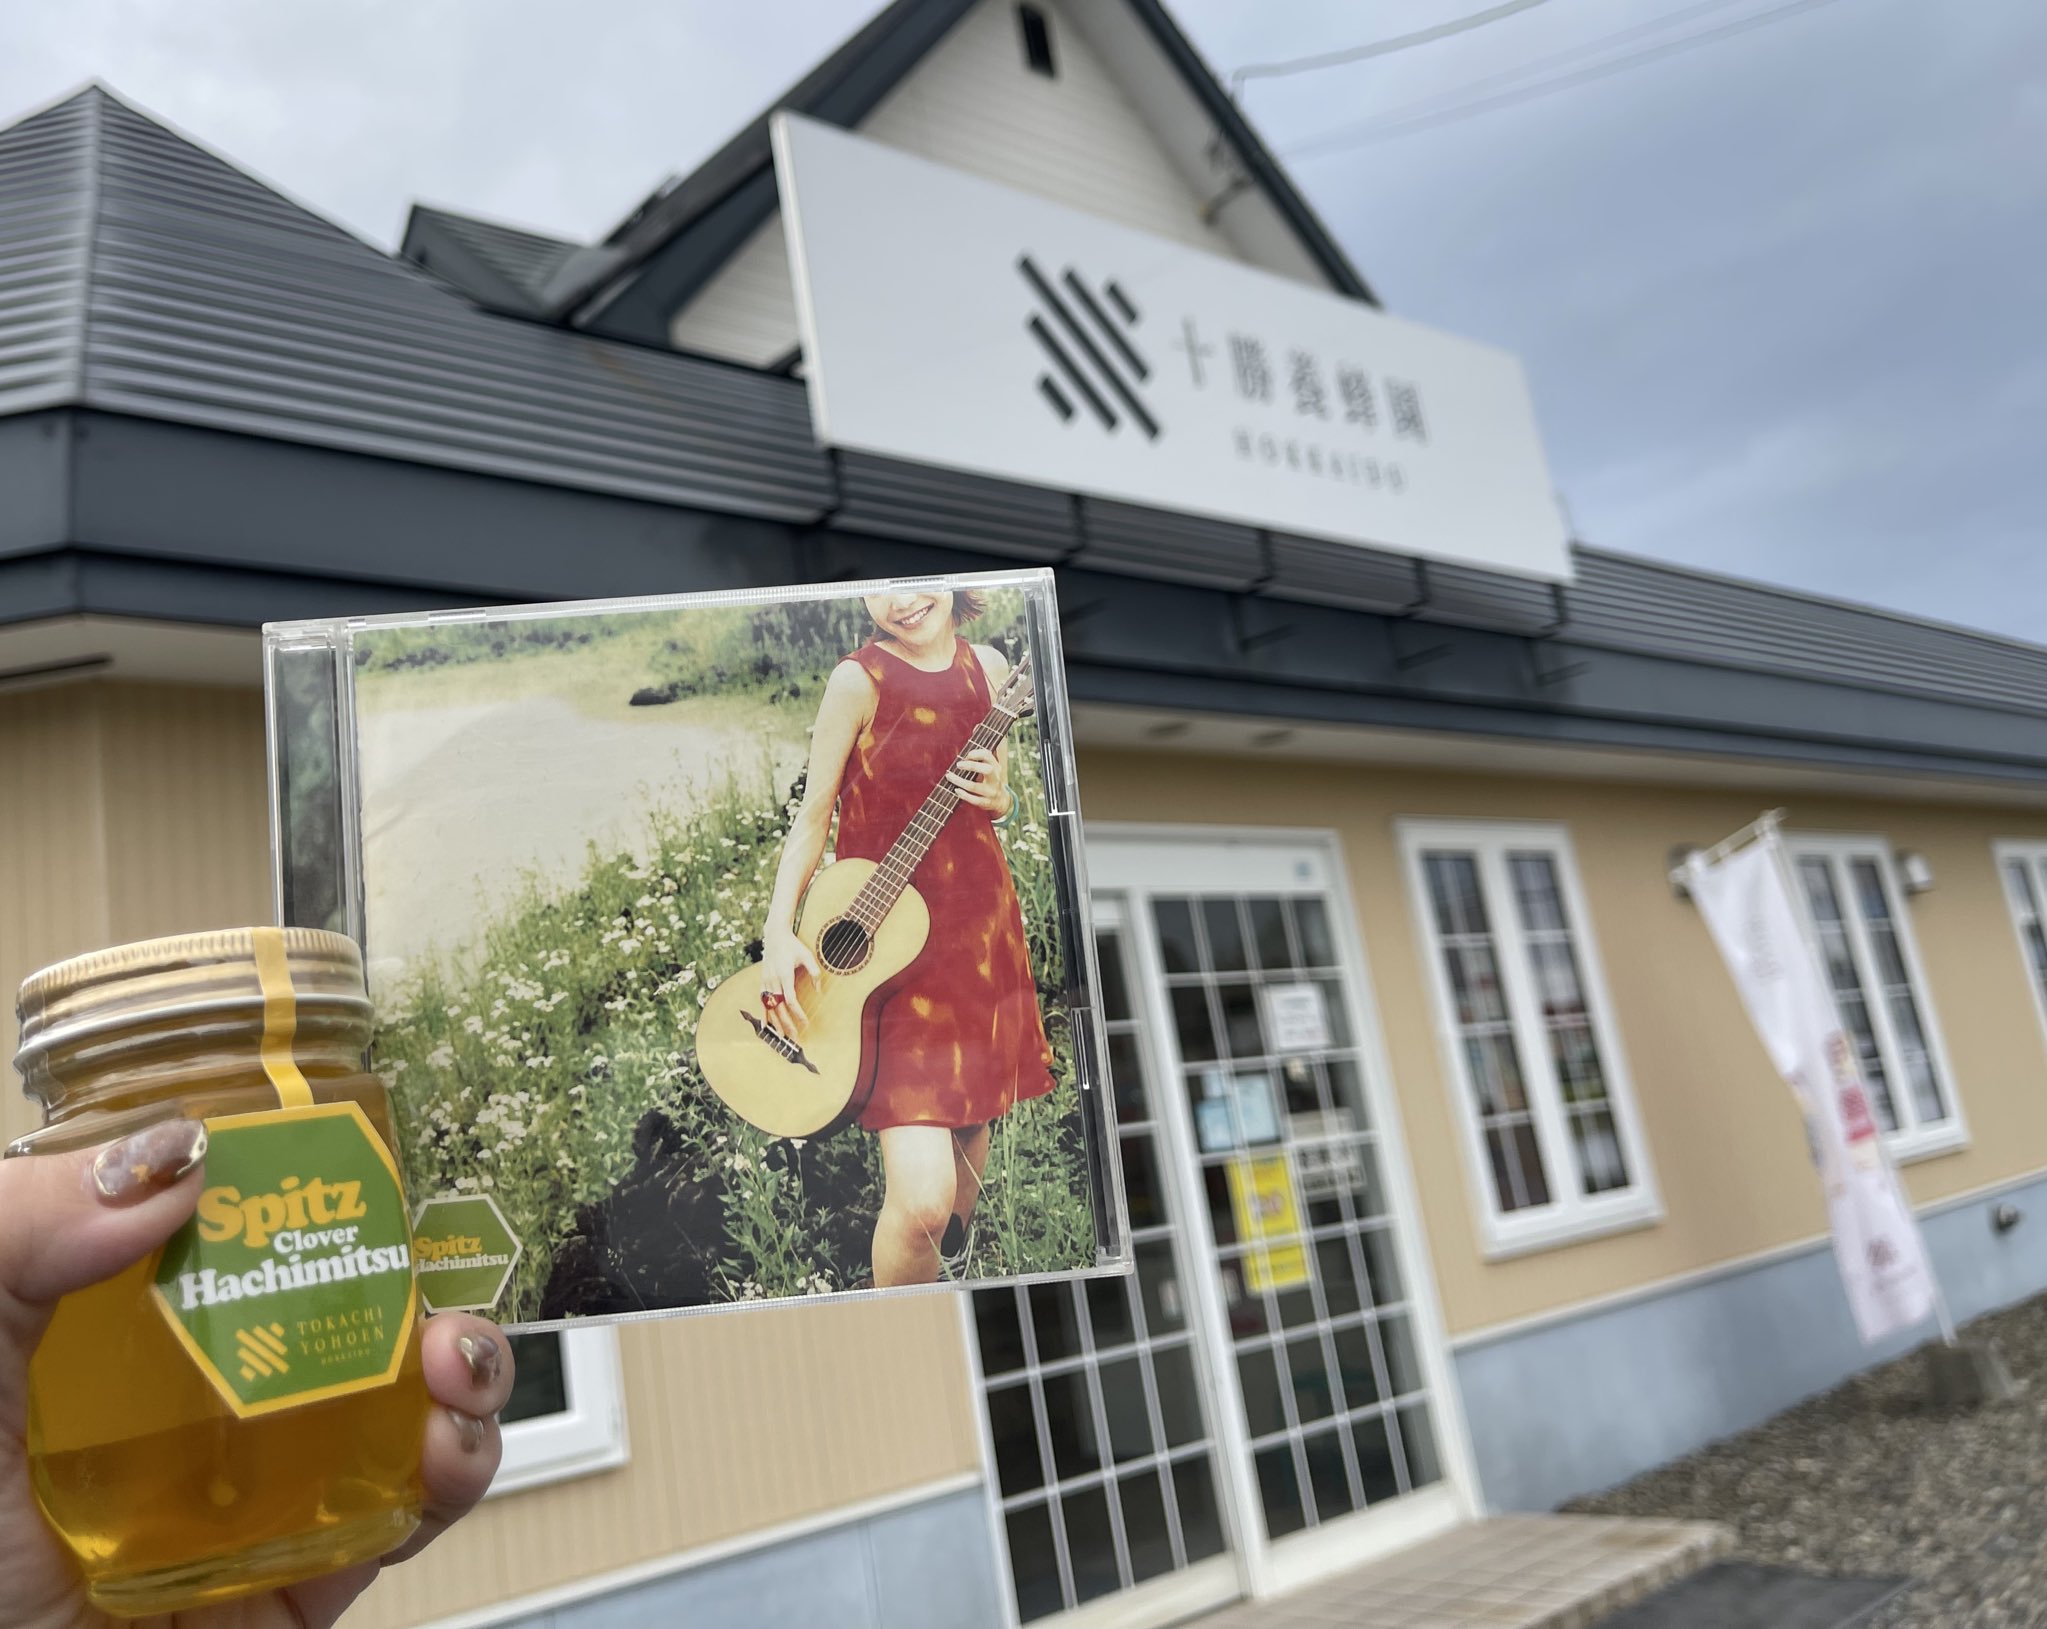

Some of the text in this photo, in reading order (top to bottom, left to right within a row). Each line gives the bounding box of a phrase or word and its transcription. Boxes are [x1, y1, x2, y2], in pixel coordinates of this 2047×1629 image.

[197, 1176, 367, 1248] Spitz
[273, 1225, 359, 1254] Clover
[413, 1234, 482, 1261] Spitz
[179, 1243, 410, 1311] Hachimitsu
[296, 1304, 383, 1336] TOKACHI
[299, 1325, 385, 1356] YOHOEN
